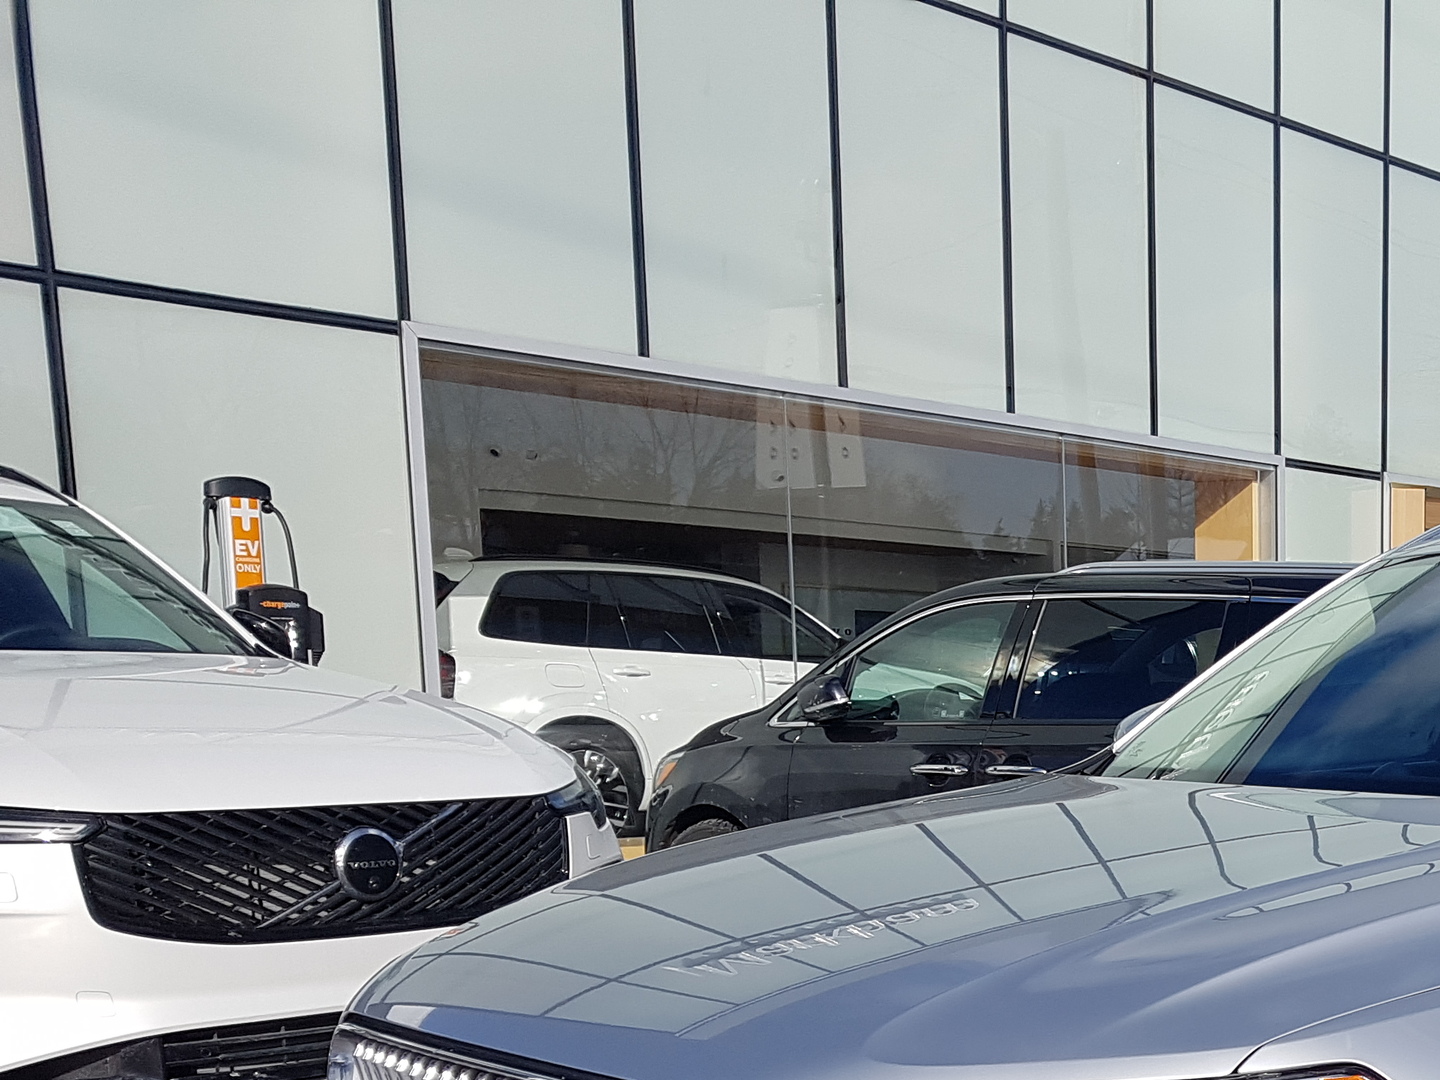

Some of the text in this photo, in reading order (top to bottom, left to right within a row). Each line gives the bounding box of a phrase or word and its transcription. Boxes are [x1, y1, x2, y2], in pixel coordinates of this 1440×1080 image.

[234, 539, 260, 556] EV
[236, 563, 261, 573] ONLY
[347, 859, 396, 869] VOLVO
